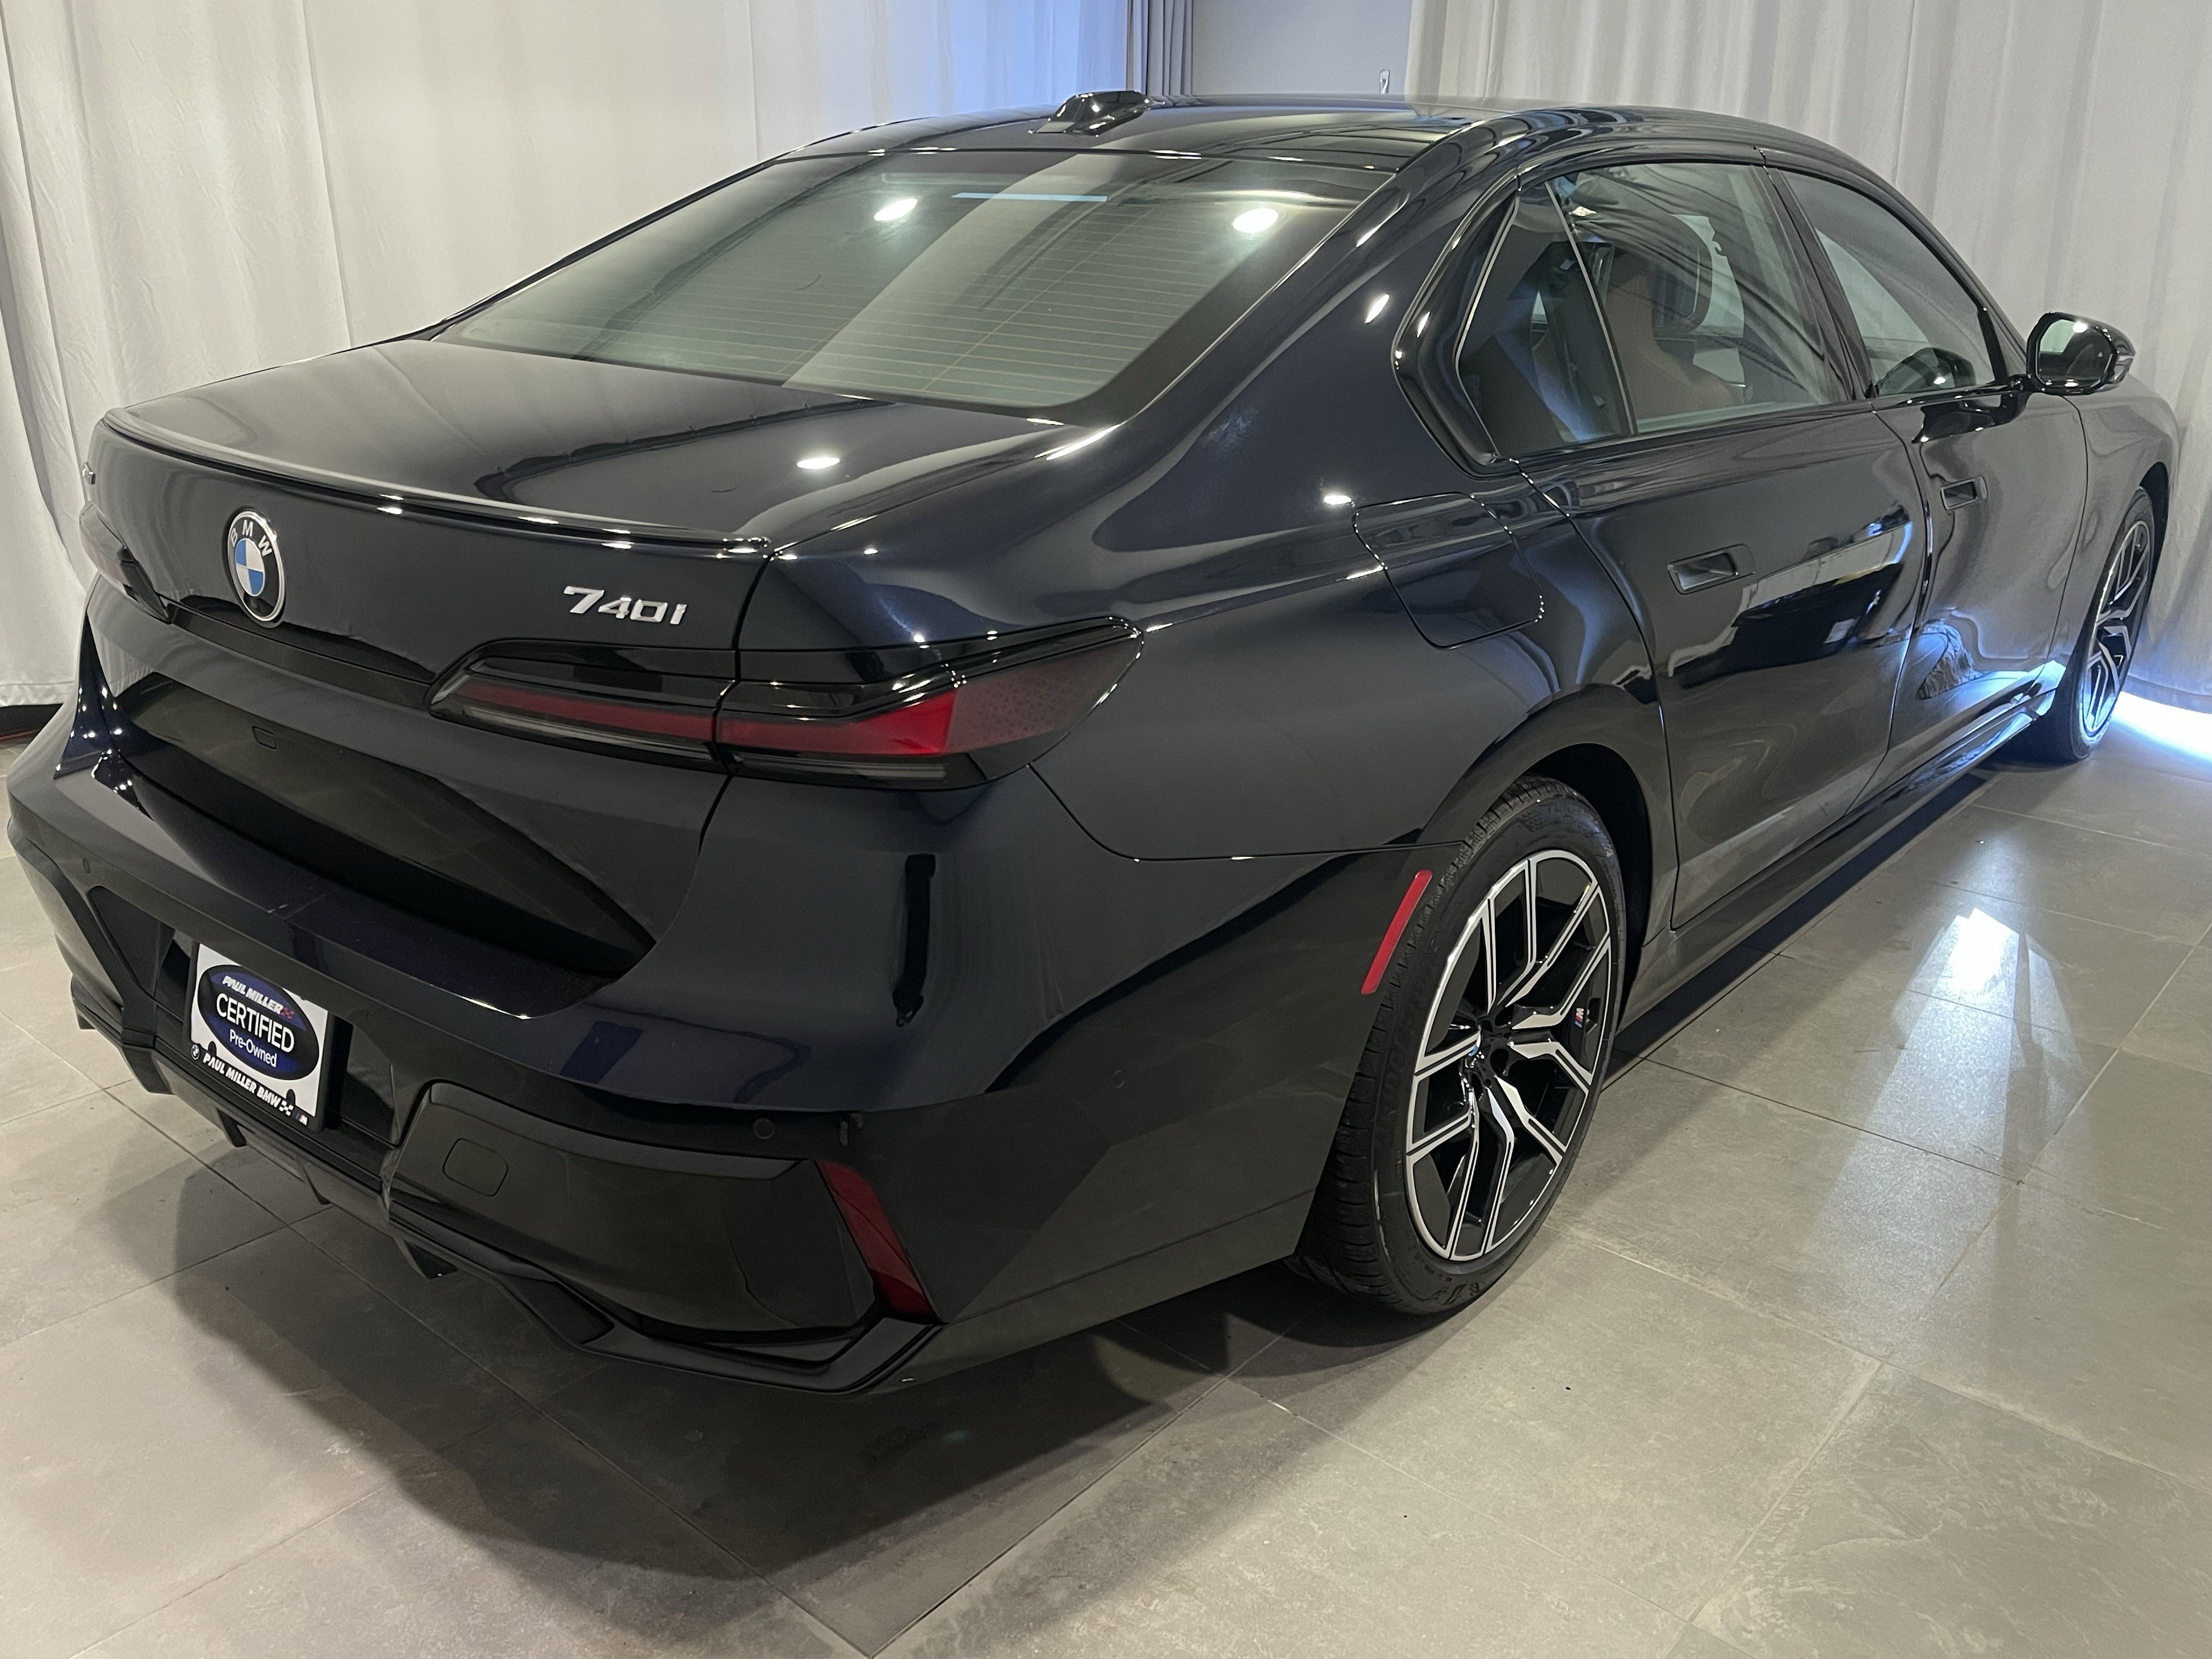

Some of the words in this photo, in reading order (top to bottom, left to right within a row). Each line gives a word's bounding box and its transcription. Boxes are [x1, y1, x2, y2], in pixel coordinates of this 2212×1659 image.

[230, 520, 272, 556] BMW
[563, 585, 687, 625] 740i
[222, 975, 246, 994] PAUL
[245, 988, 284, 1014] MILLER
[216, 993, 295, 1052] CERTIFIED
[229, 1029, 277, 1068] Pre-Owned
[202, 1053, 225, 1073] PAUL
[225, 1067, 257, 1093] MILLER
[257, 1086, 281, 1108] BMW
